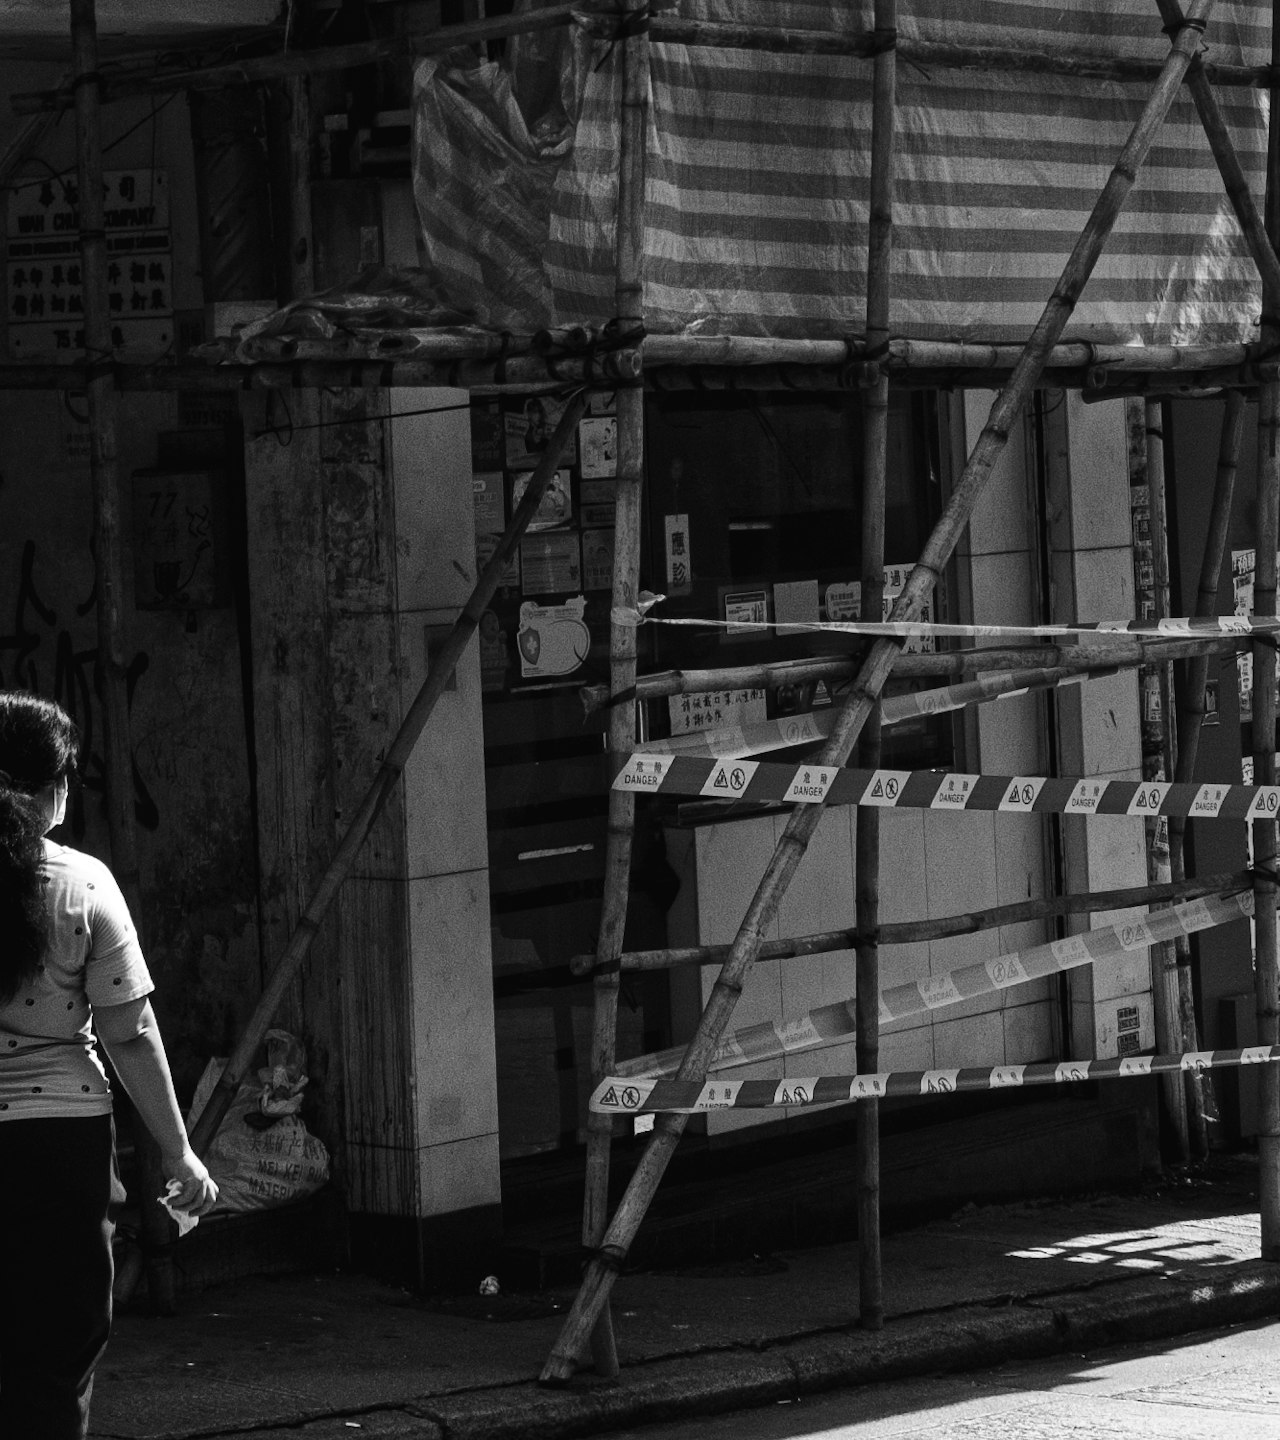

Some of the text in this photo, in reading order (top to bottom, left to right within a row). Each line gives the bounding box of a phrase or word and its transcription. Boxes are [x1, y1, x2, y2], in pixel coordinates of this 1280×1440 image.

[636, 761, 663, 774] 危險
[624, 773, 658, 786] DANGER
[803, 771, 828, 785] 危險
[793, 784, 824, 797] DANGER
[939, 791, 964, 803] DANGER
[1071, 797, 1096, 808] DANGER
[1195, 801, 1218, 811] DANGER
